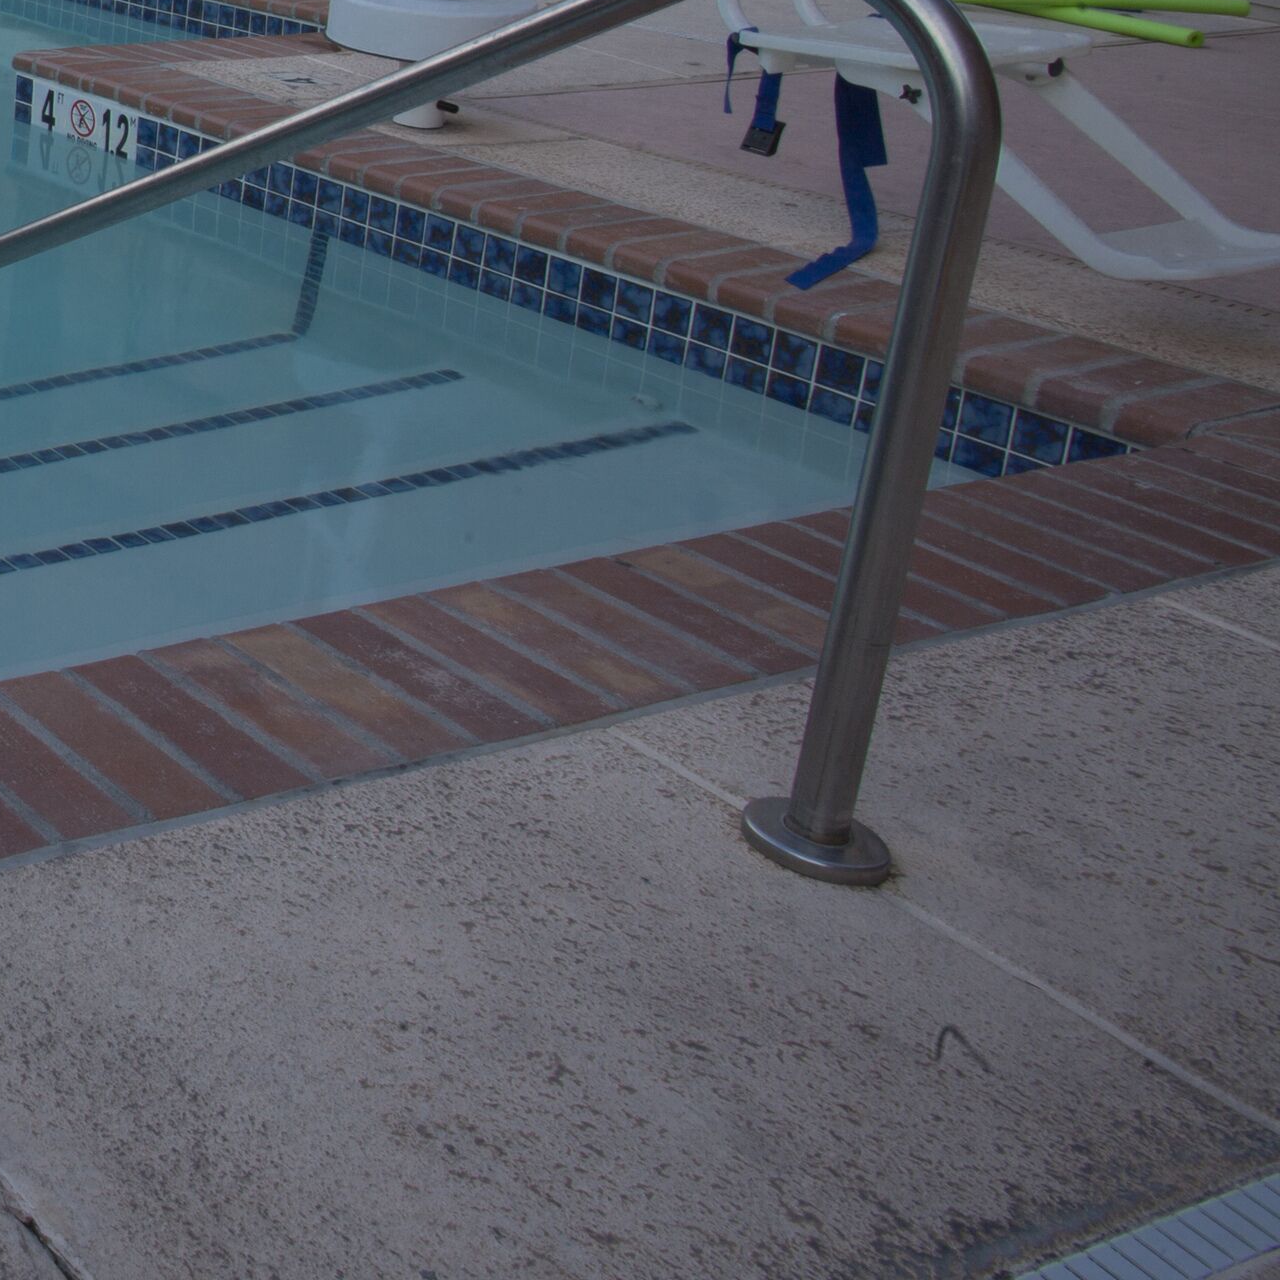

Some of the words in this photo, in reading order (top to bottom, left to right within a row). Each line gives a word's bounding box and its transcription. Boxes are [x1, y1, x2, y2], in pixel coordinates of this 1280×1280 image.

[42, 89, 56, 132] 4
[57, 92, 65, 105] FT
[102, 108, 129, 160] 1.2
